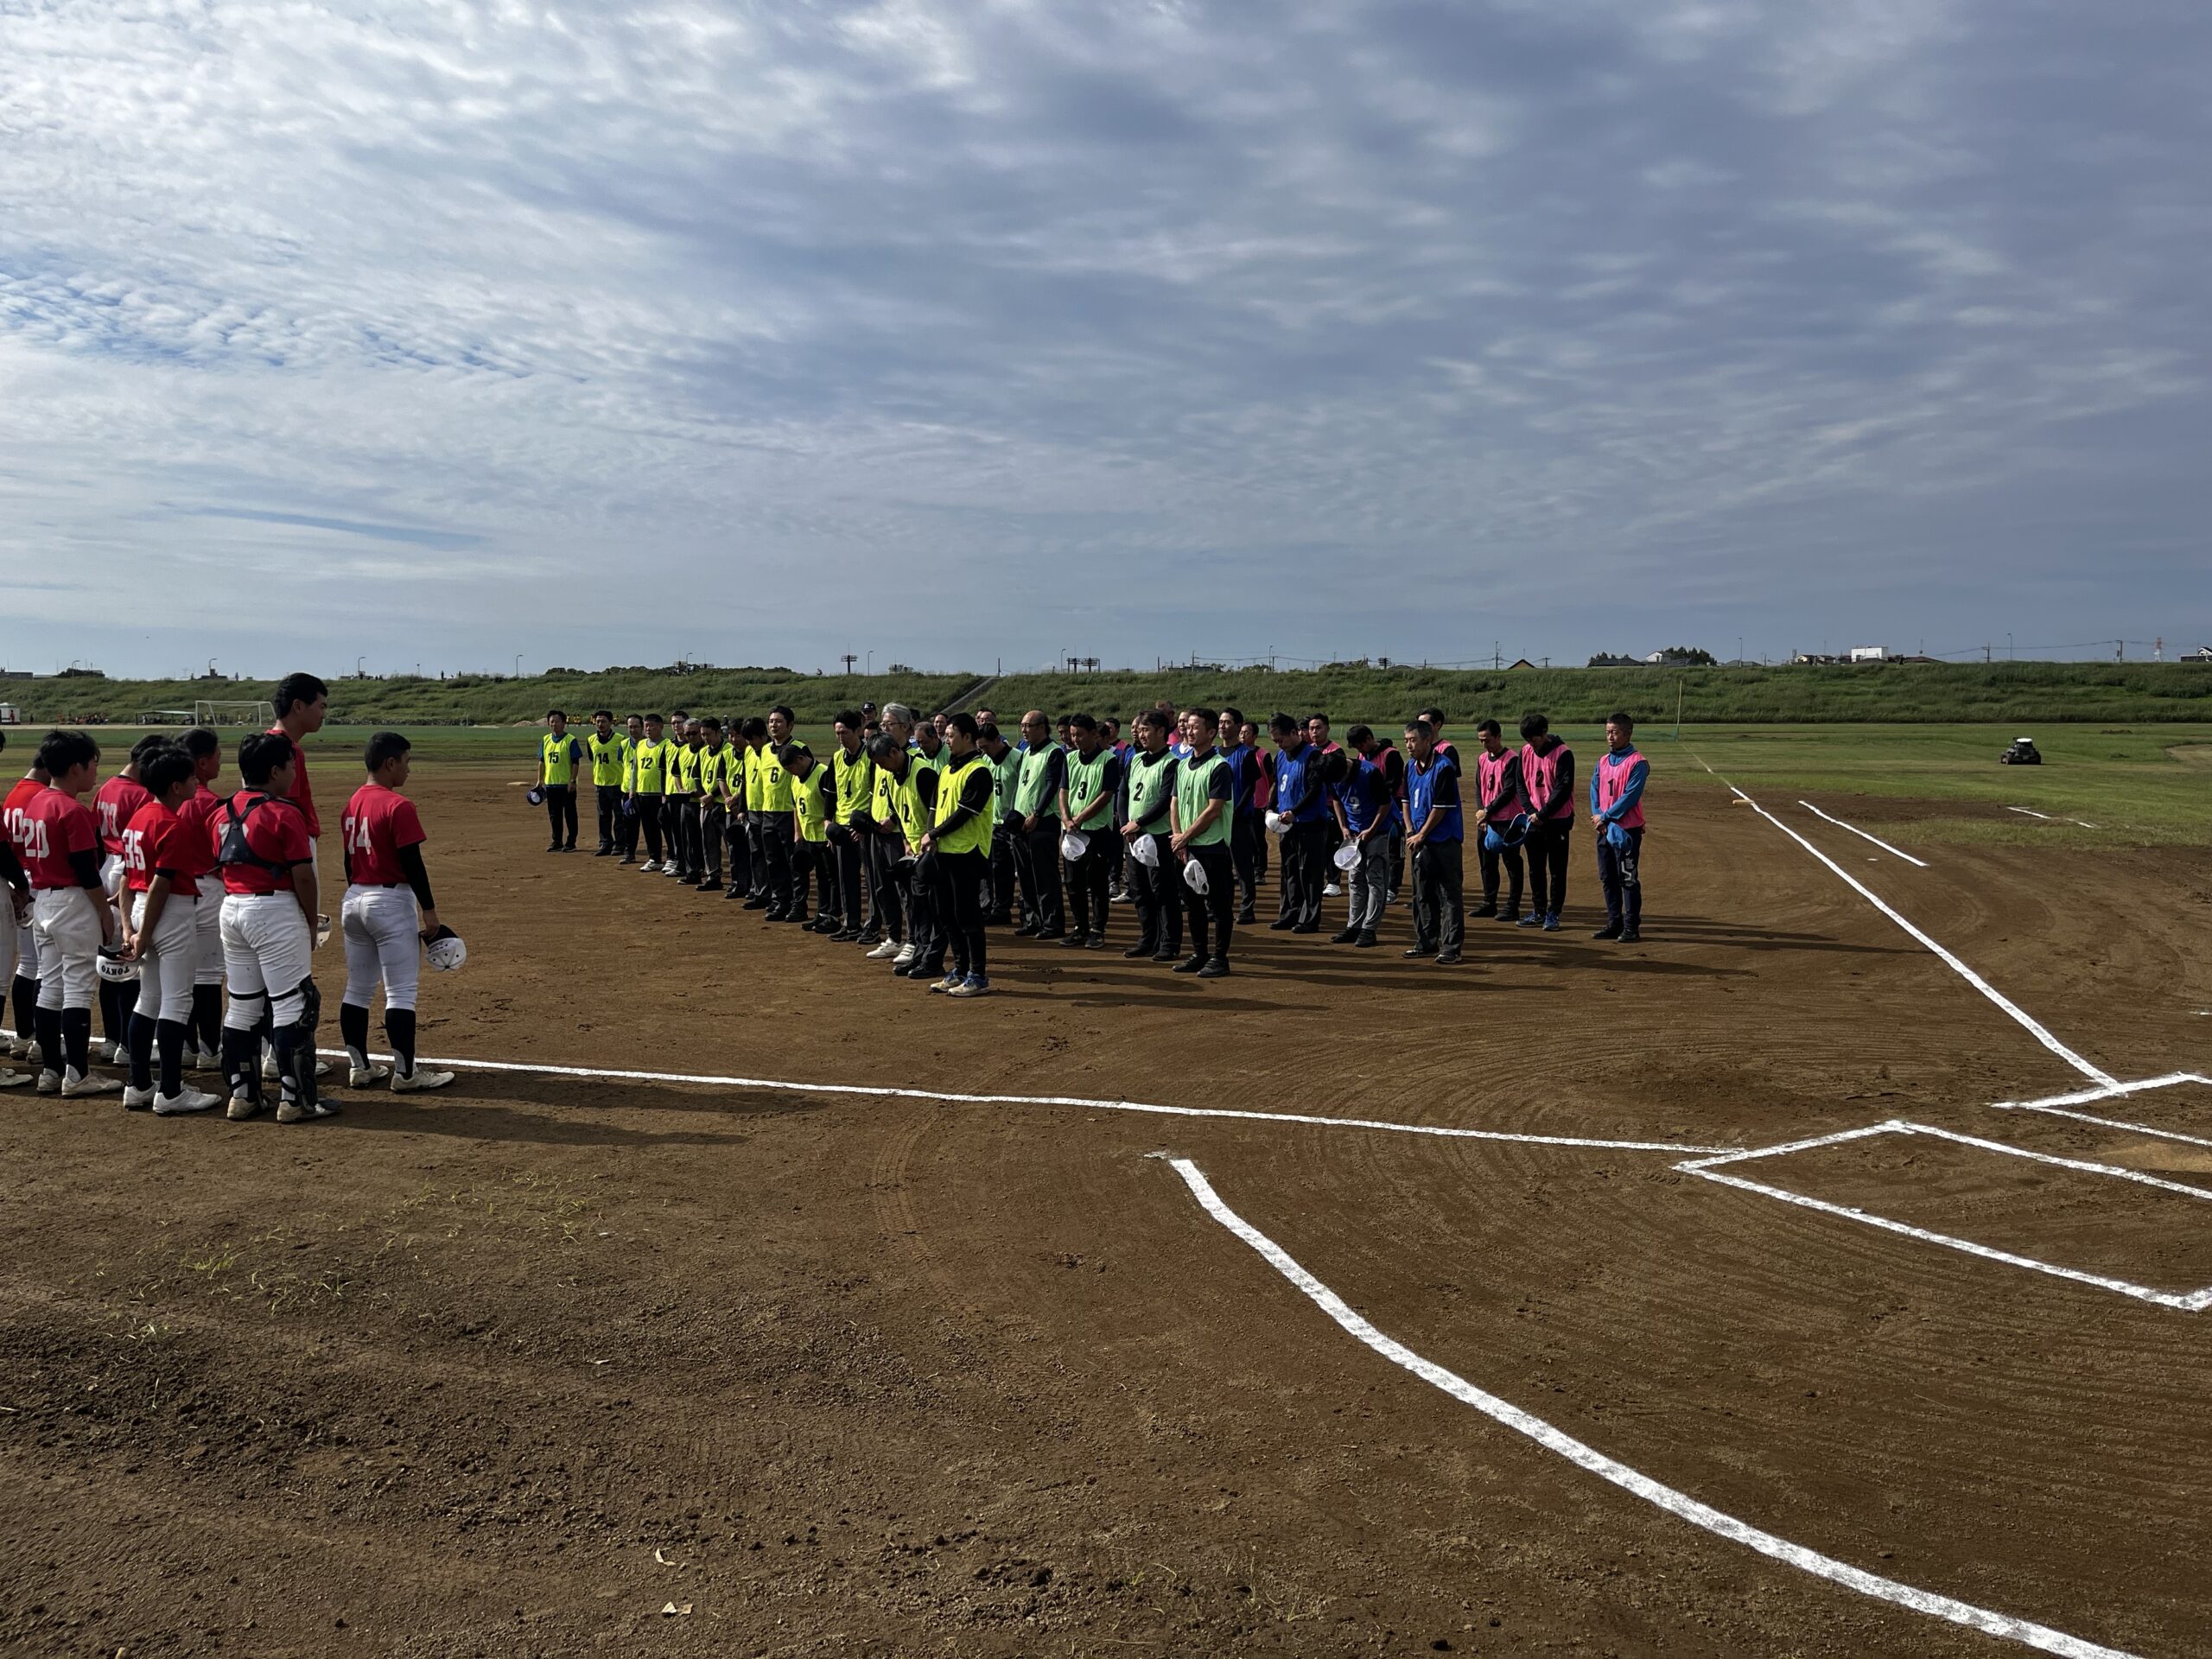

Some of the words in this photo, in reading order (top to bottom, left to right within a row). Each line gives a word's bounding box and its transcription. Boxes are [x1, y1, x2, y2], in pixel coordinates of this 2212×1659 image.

[548, 752, 559, 764] 15
[597, 753, 610, 765] 14
[640, 757, 653, 770] 12
[707, 770, 714, 785] 9
[732, 772, 742, 788] 8
[752, 768, 759, 784] 7
[770, 767, 779, 784] 6
[1021, 769, 1031, 786] 4
[1280, 773, 1288, 792] 3
[1535, 770, 1546, 788] 2
[879, 777, 888, 798] 3
[1077, 781, 1088, 800] 3
[1133, 781, 1144, 802] 2
[1607, 778, 1615, 797] 1
[798, 797, 806, 815] 5
[940, 787, 949, 809] 1
[1414, 788, 1420, 809] 1
[23, 817, 50, 858] 20
[122, 829, 146, 871] 35
[101, 964, 130, 976] TOKYO
